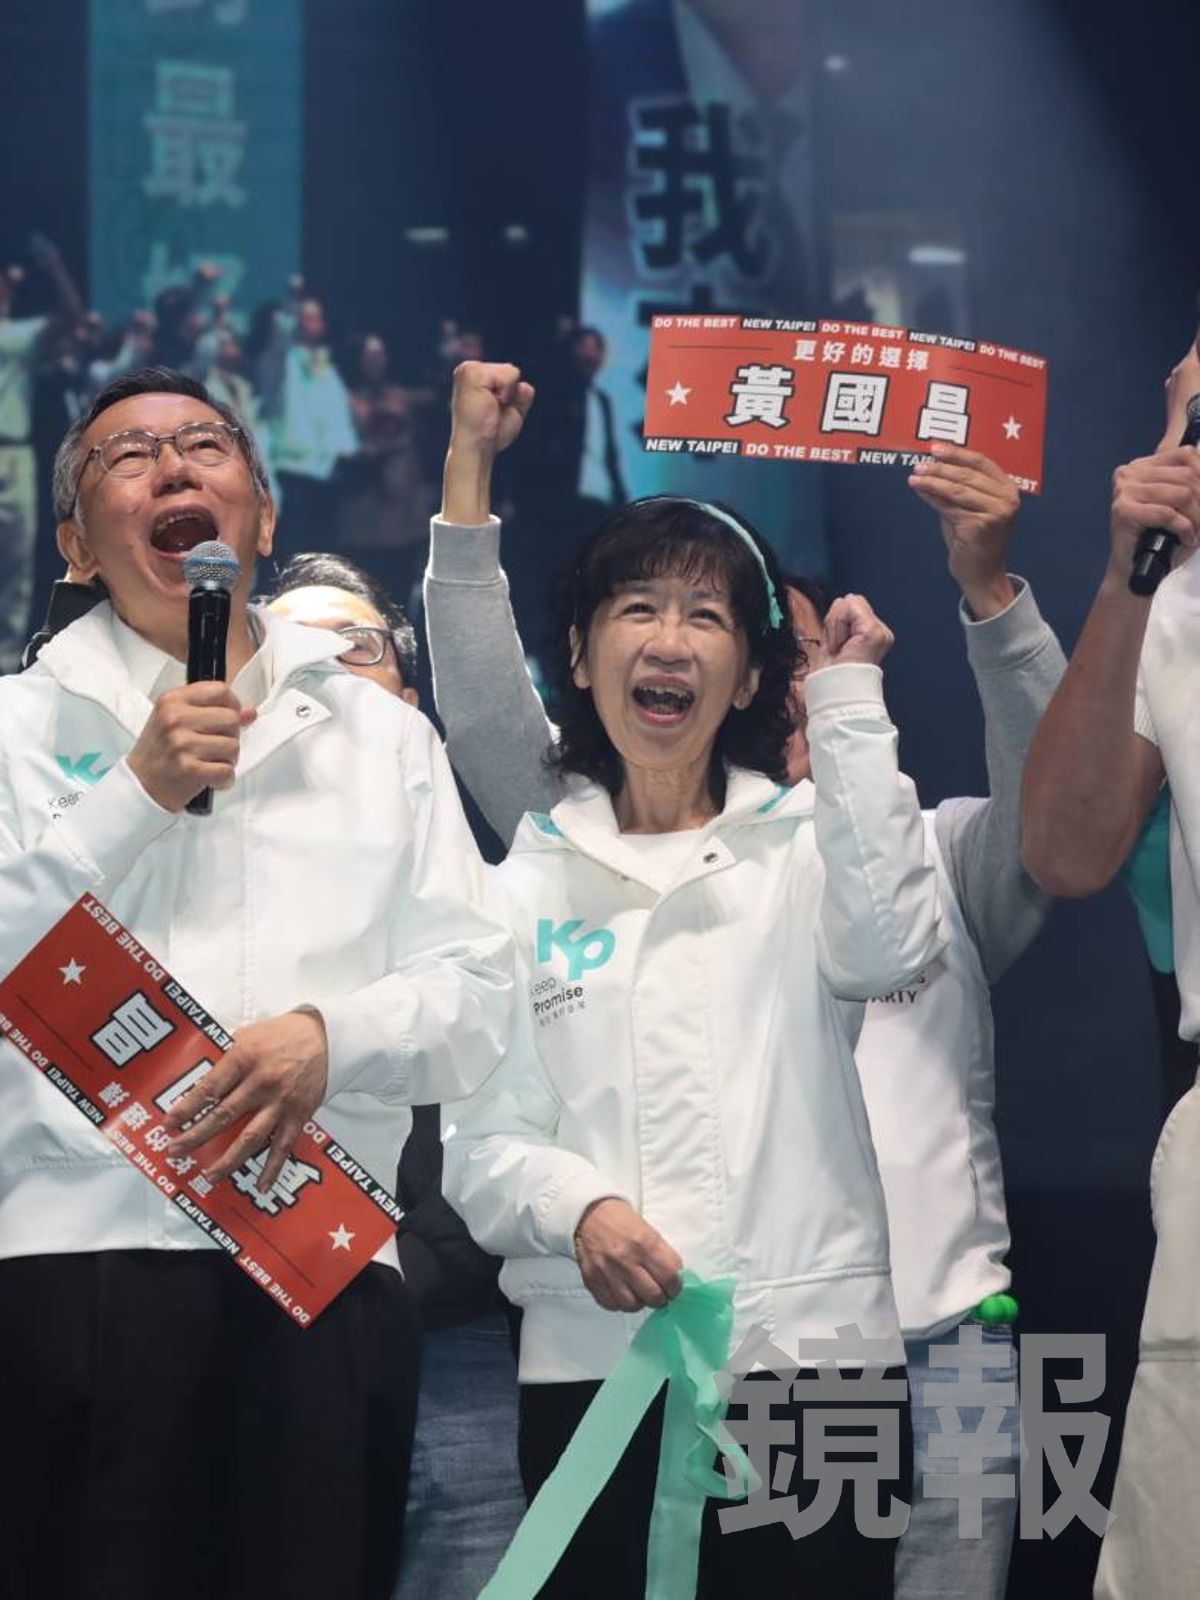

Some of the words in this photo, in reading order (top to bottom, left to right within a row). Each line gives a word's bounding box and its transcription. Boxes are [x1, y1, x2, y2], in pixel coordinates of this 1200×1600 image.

[654, 318, 672, 328] DO
[676, 318, 700, 328] THE
[703, 318, 737, 328] BEST
[743, 319, 772, 329] NEW
[776, 320, 816, 332] TAIPEI
[822, 323, 841, 333] DO
[844, 324, 868, 336] THE
[871, 327, 904, 339] BEST
[909, 332, 938, 344] NEW
[939, 336, 976, 352] TAIPEI
[979, 344, 995, 356] DO
[998, 348, 1019, 362] THE
[1019, 354, 1046, 369] BEST
[793, 339, 930, 371] 更好的選擇
[725, 364, 969, 446] 黃國昌
[646, 439, 682, 451] NEW
[687, 440, 738, 454] TAIPEI
[746, 444, 769, 455] DO
[774, 445, 806, 458] THE
[810, 447, 852, 461] BEST
[859, 451, 898, 465] NEW
[1008, 474, 1038, 491] EST
[82, 900, 119, 935] BEST
[116, 931, 143, 963] THE
[144, 960, 166, 981] DO
[530, 977, 556, 995] eep
[533, 986, 584, 1015] Promise
[164, 982, 203, 1025] TAIPEI
[9, 1029, 32, 1052] THE
[31, 1051, 49, 1067] DO
[47, 1067, 80, 1100] TAIPEI
[77, 1098, 104, 1123] NEW
[90, 990, 321, 1215] 黃昌
[303, 1122, 327, 1144] DO
[132, 1152, 157, 1176] THE
[326, 1144, 372, 1190] TAIPEI
[157, 1176, 175, 1193] DO
[175, 1193, 212, 1230] TAIPEI
[370, 1188, 405, 1222] NEW
[211, 1228, 240, 1255] NEW
[240, 1256, 272, 1285] BEST
[270, 1283, 292, 1307] THE
[292, 1306, 310, 1323] DO
